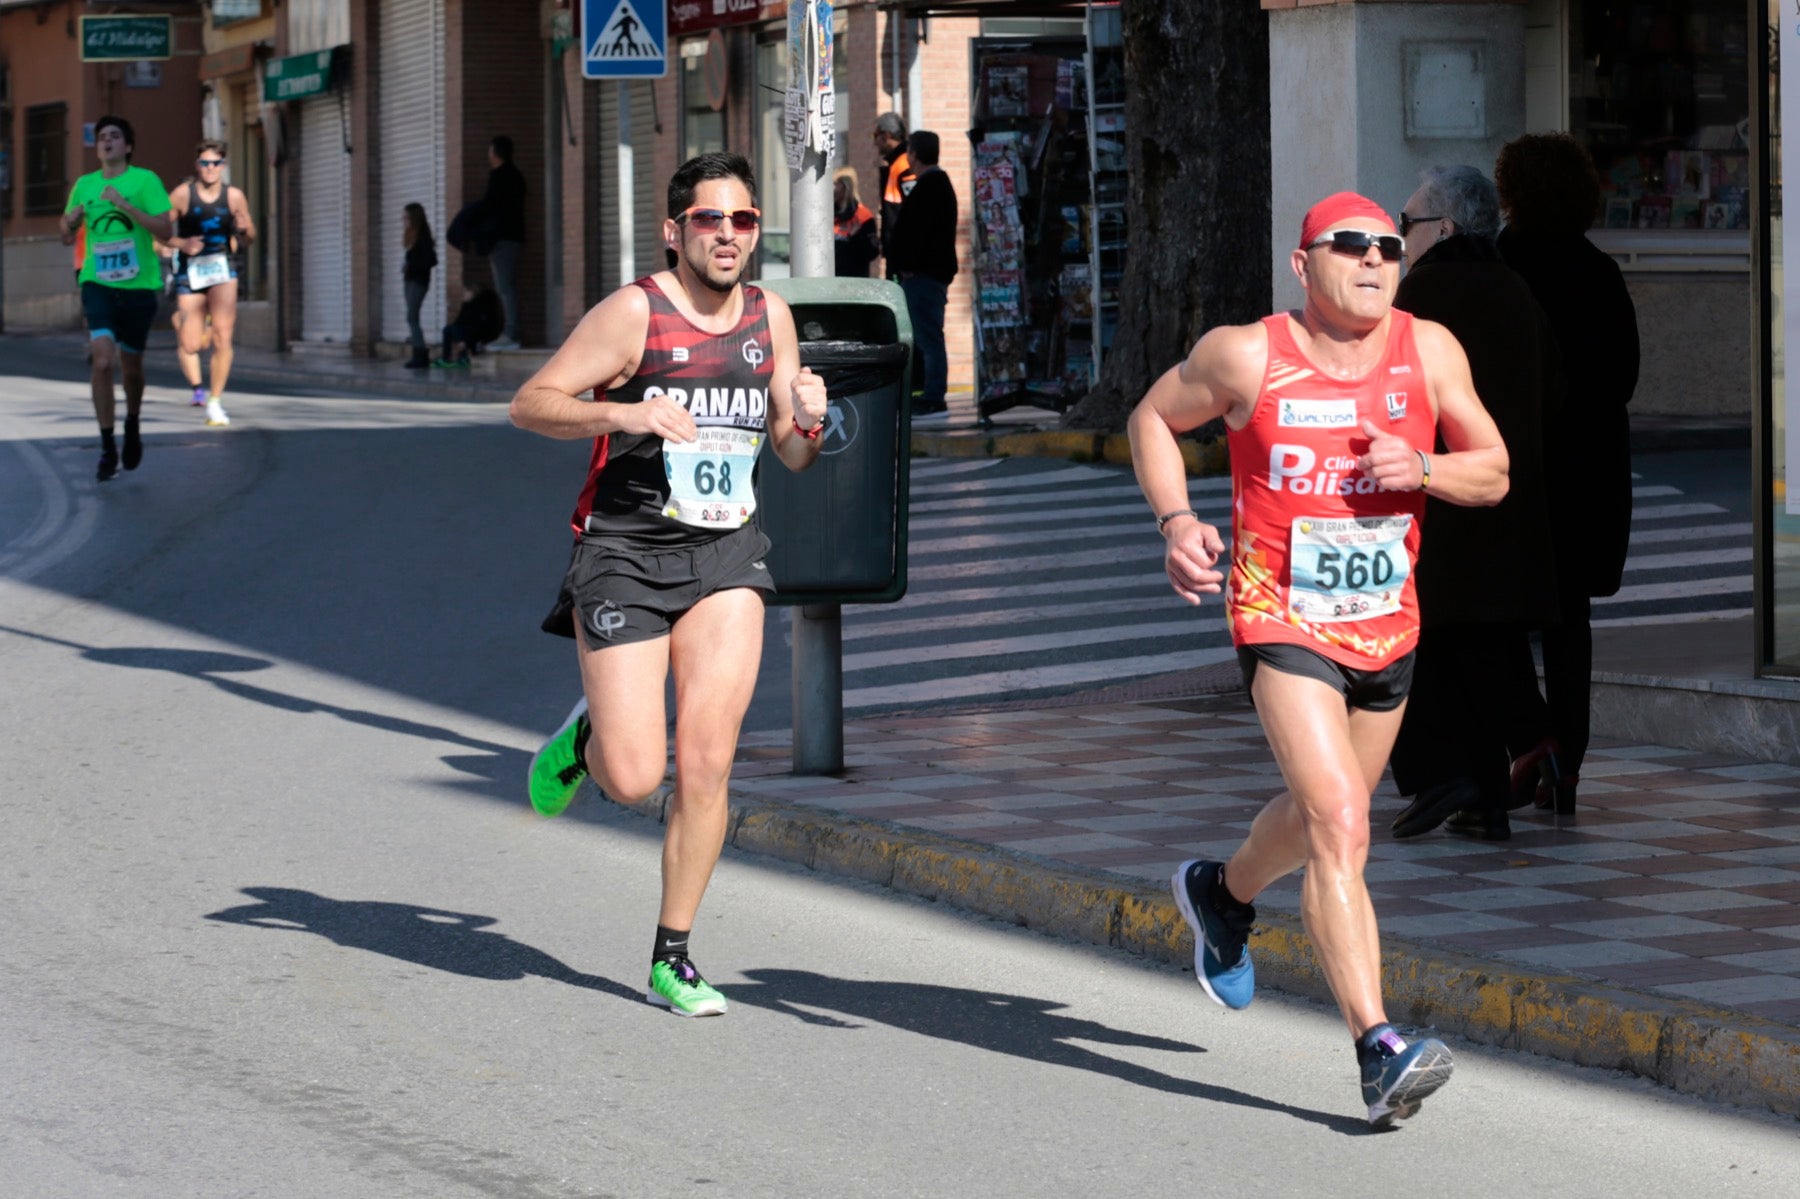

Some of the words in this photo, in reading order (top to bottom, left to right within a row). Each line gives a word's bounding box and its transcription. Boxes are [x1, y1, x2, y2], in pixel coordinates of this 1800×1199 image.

[100, 252, 130, 269] 778
[694, 460, 732, 495] 68
[1315, 550, 1393, 590] 560
